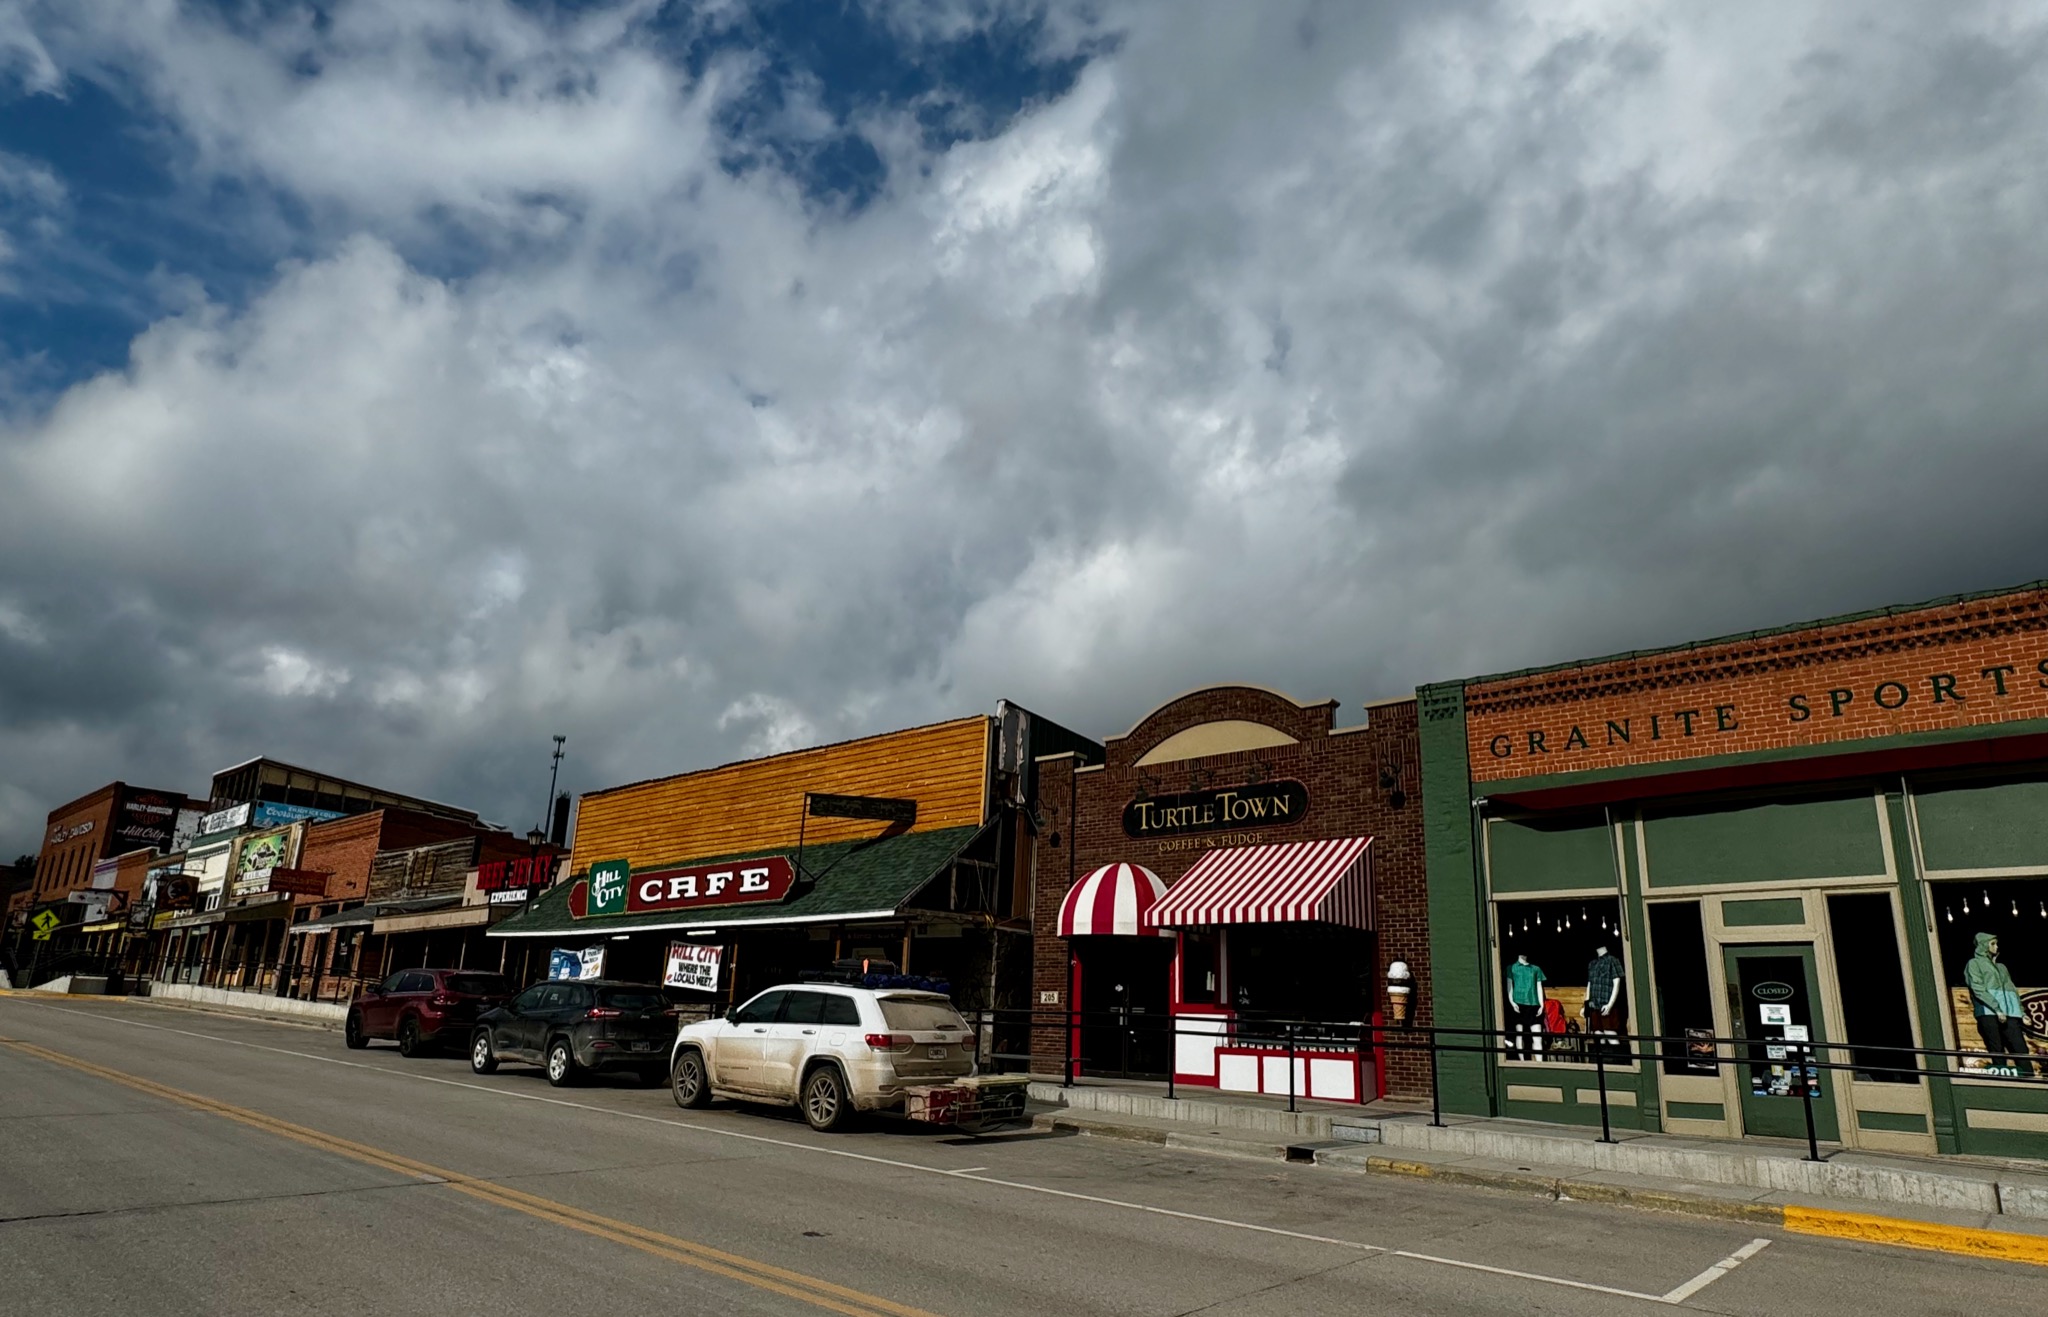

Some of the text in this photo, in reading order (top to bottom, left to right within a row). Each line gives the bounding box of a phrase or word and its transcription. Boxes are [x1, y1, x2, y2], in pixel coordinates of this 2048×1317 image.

[1489, 704, 1739, 758] GRANITE
[1134, 792, 1290, 830] TURTLE TOWN
[117, 825, 144, 837] Hill
[1158, 832, 1264, 852] COFFEE & FUDGE
[476, 861, 507, 890] BEEF
[593, 869, 621, 889] HILL
[639, 867, 770, 902] CAFE
[490, 889, 528, 903] EXPERIENC
[592, 884, 625, 908] CITY
[671, 943, 722, 964] HILL CITY
[678, 962, 711, 976] WHERE THE
[673, 972, 695, 985] LOCALS
[696, 975, 713, 988] MEET
[1044, 993, 1056, 1002] 205
